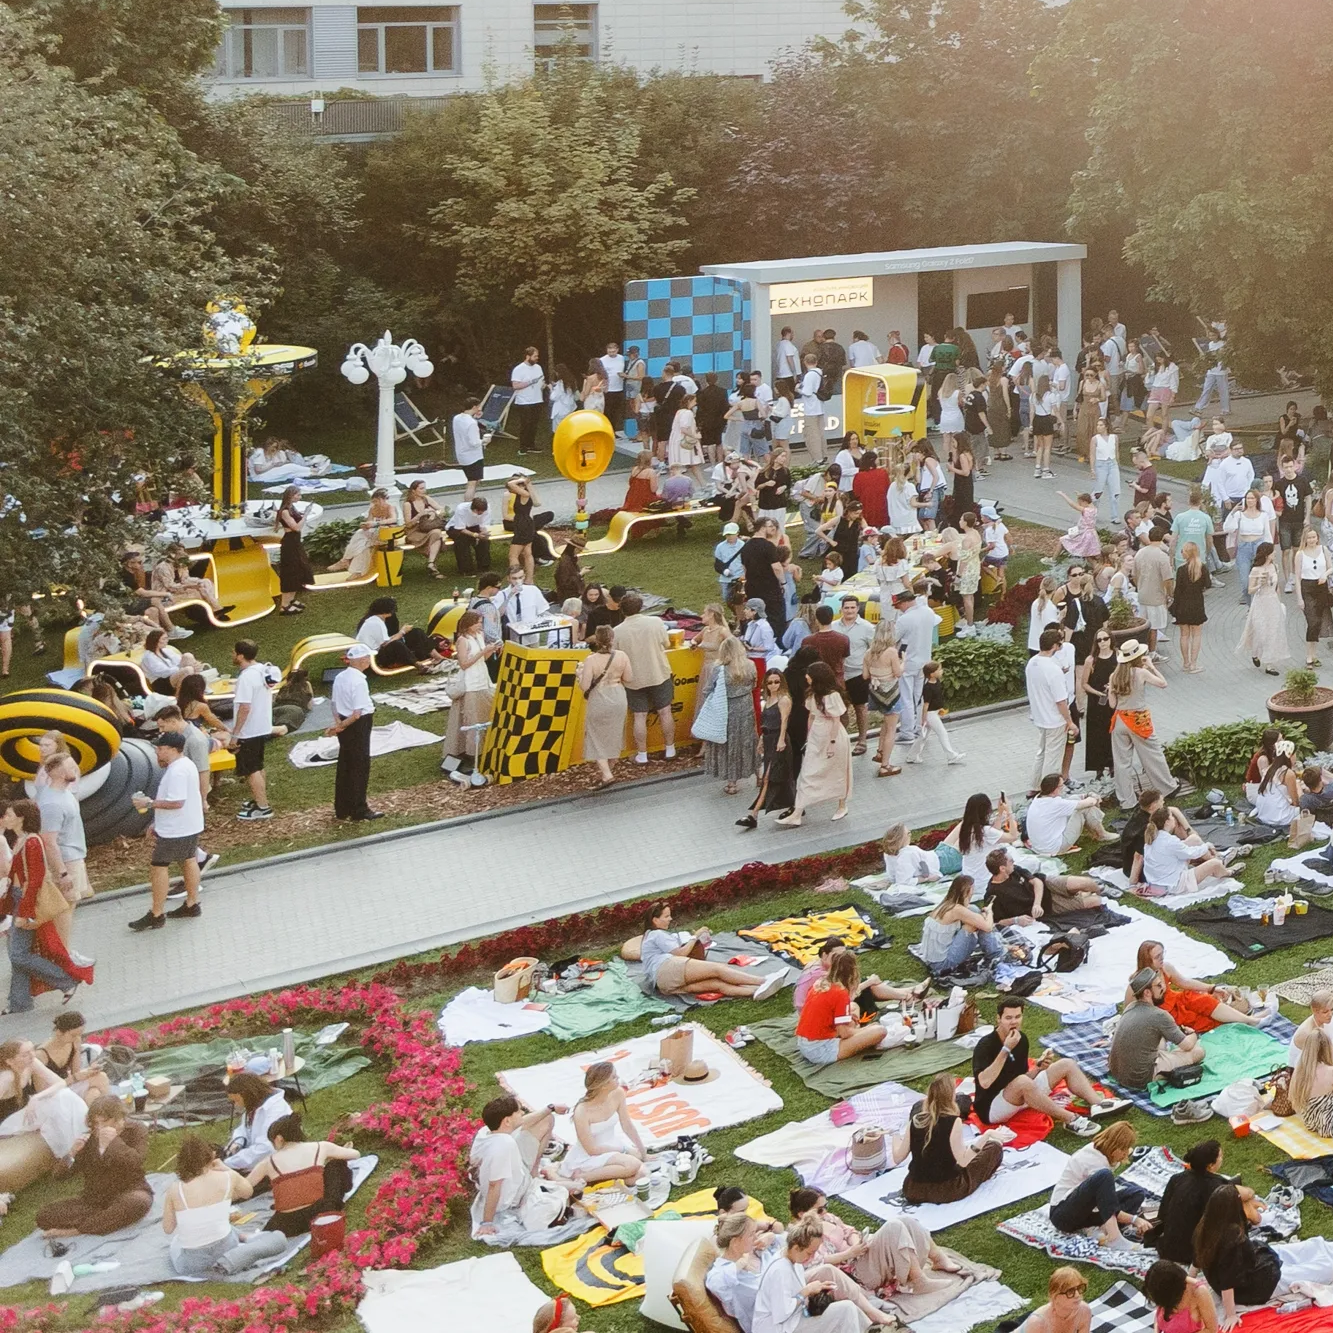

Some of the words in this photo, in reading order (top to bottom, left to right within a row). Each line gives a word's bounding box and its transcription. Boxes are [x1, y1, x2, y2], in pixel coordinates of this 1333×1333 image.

[884, 260, 921, 271] Samsung
[921, 258, 949, 268] Galaxy
[770, 291, 868, 311] ТЕХНОПАРК
